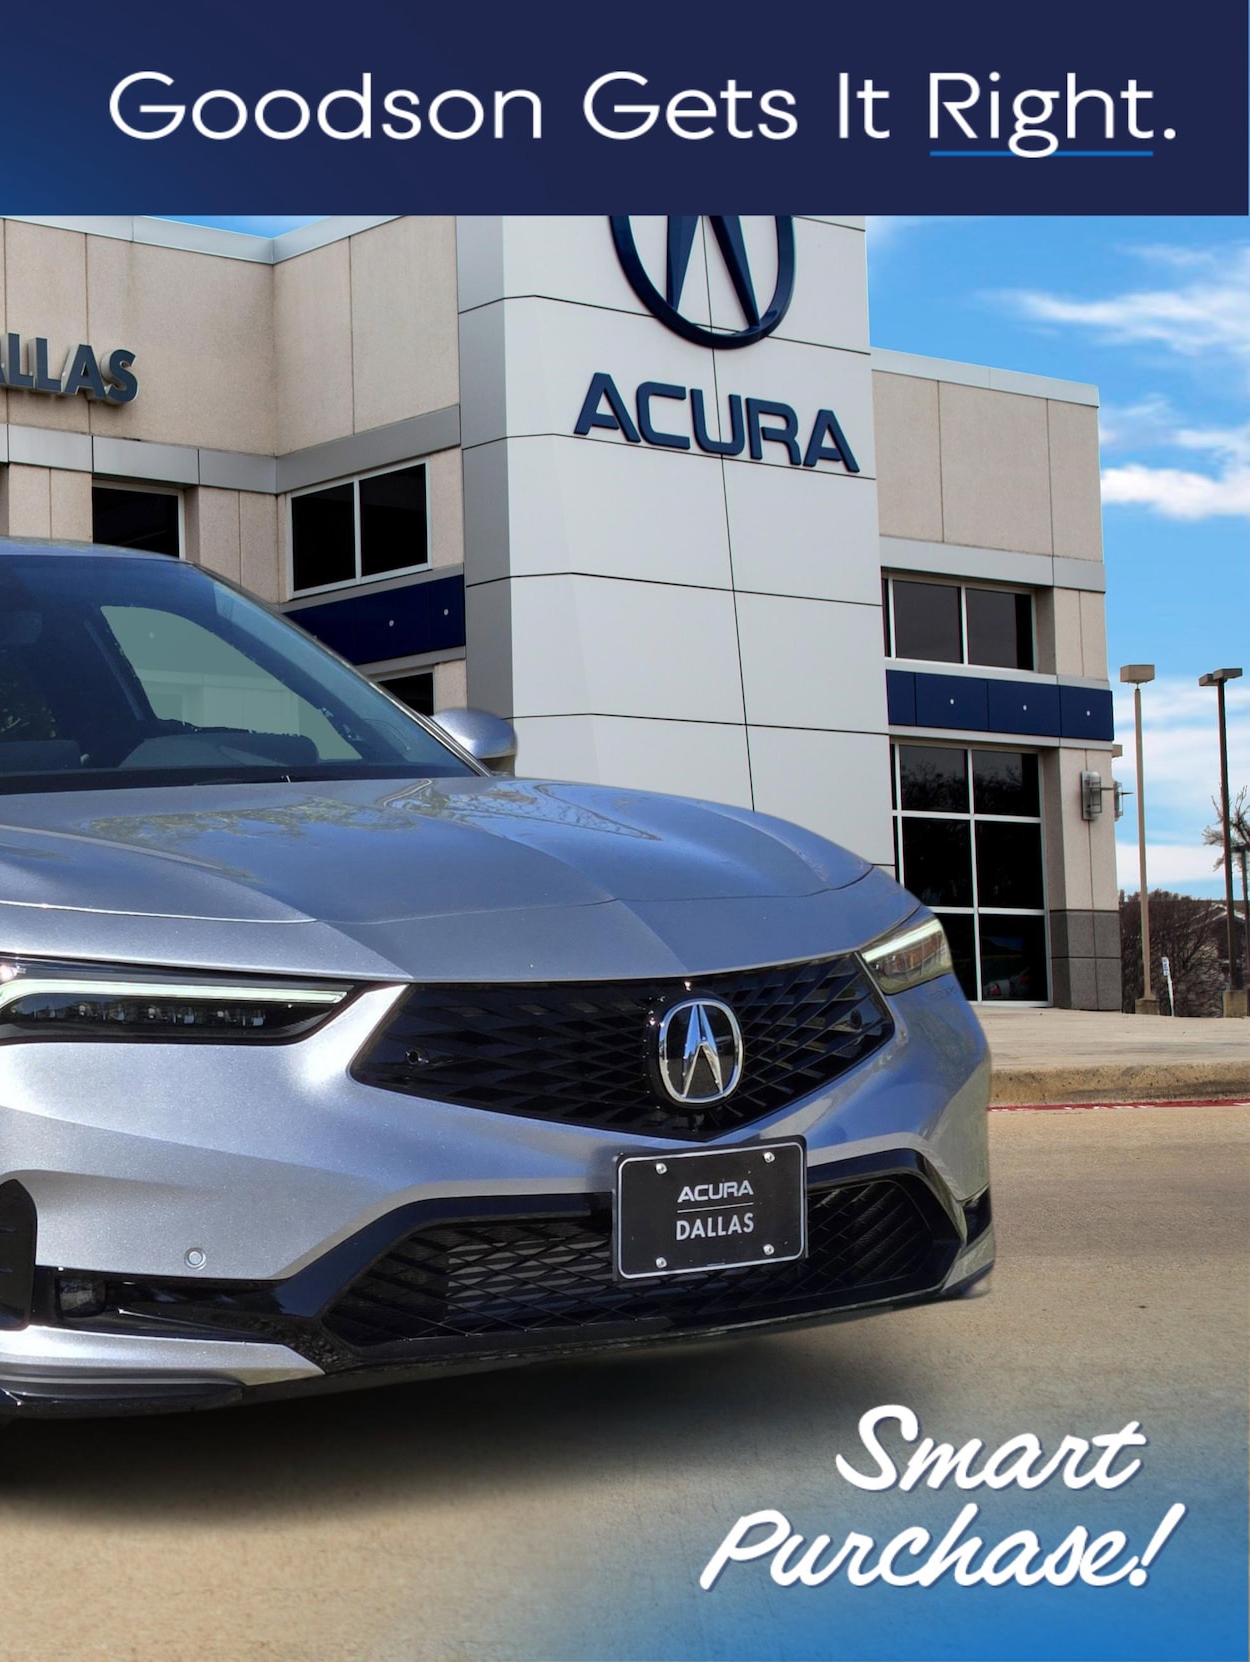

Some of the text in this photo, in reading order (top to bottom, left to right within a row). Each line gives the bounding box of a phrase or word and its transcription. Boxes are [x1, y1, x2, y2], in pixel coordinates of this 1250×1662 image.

[574, 372, 861, 474] ACURA
[677, 1180, 755, 1203] ACURA
[676, 1212, 755, 1241] DALLAS
